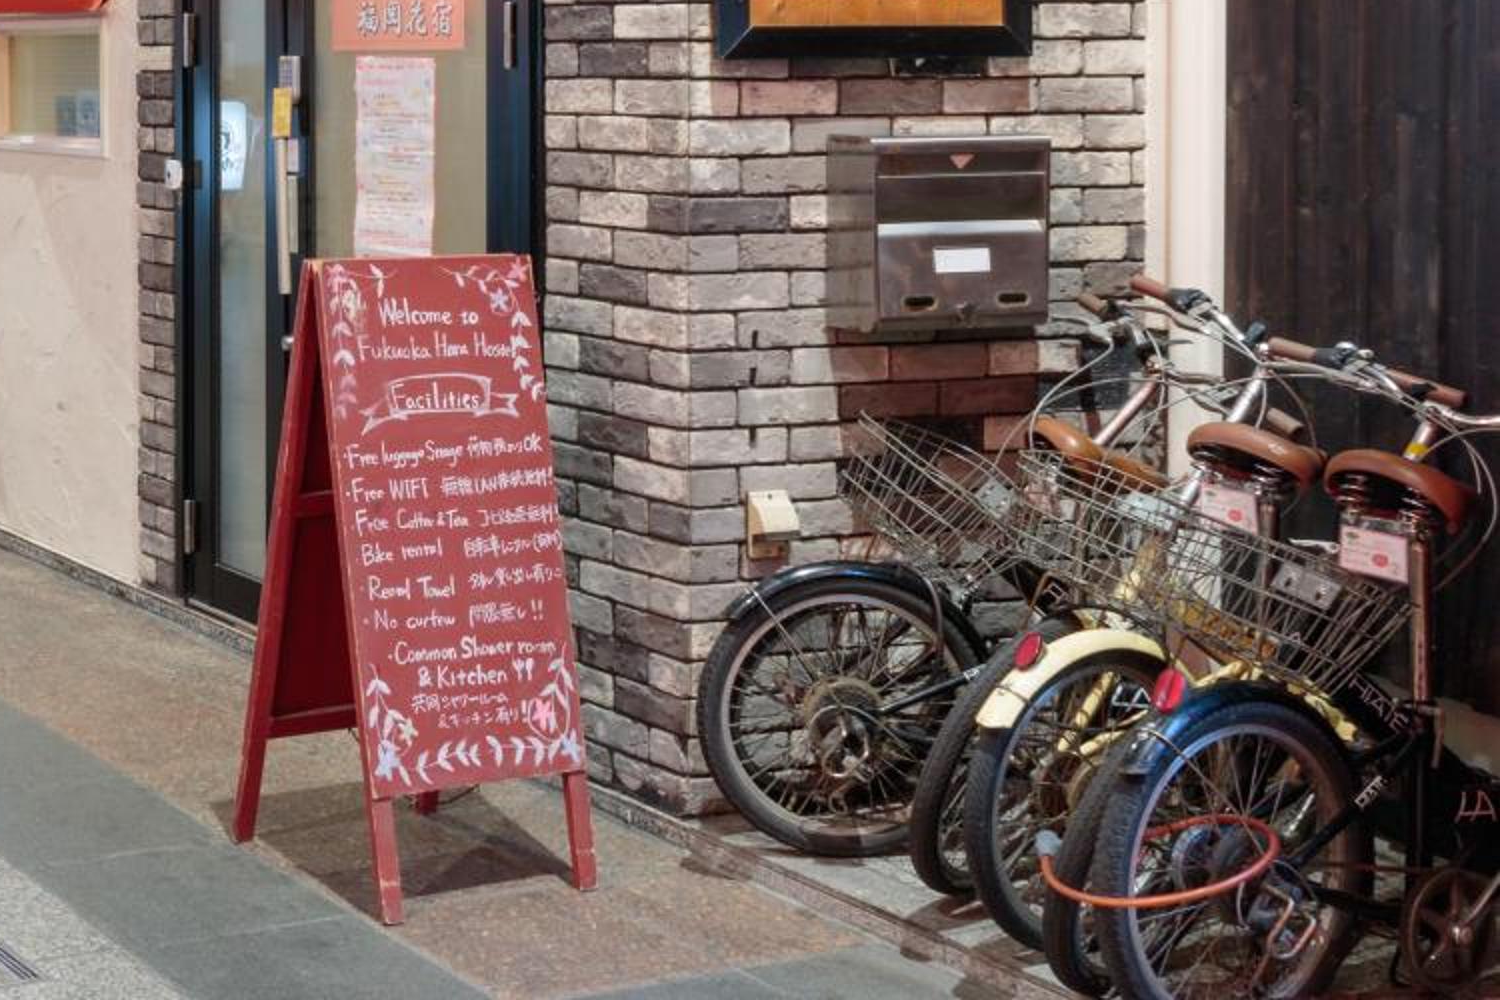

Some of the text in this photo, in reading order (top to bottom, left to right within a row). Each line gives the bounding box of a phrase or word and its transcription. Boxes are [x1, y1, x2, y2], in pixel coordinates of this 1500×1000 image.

[378, 297, 479, 327] Welcome to
[357, 334, 432, 361] Fukuoka
[435, 331, 469, 358] Hana
[390, 382, 480, 410] Facilities
[346, 443, 379, 469] Free
[351, 477, 385, 502] Free
[355, 508, 388, 537] Free
[361, 542, 393, 567] Bike
[416, 574, 455, 597] Towel
[373, 608, 397, 631] No
[395, 635, 557, 665] Common Shower room
[418, 664, 507, 688] & Kitchen
